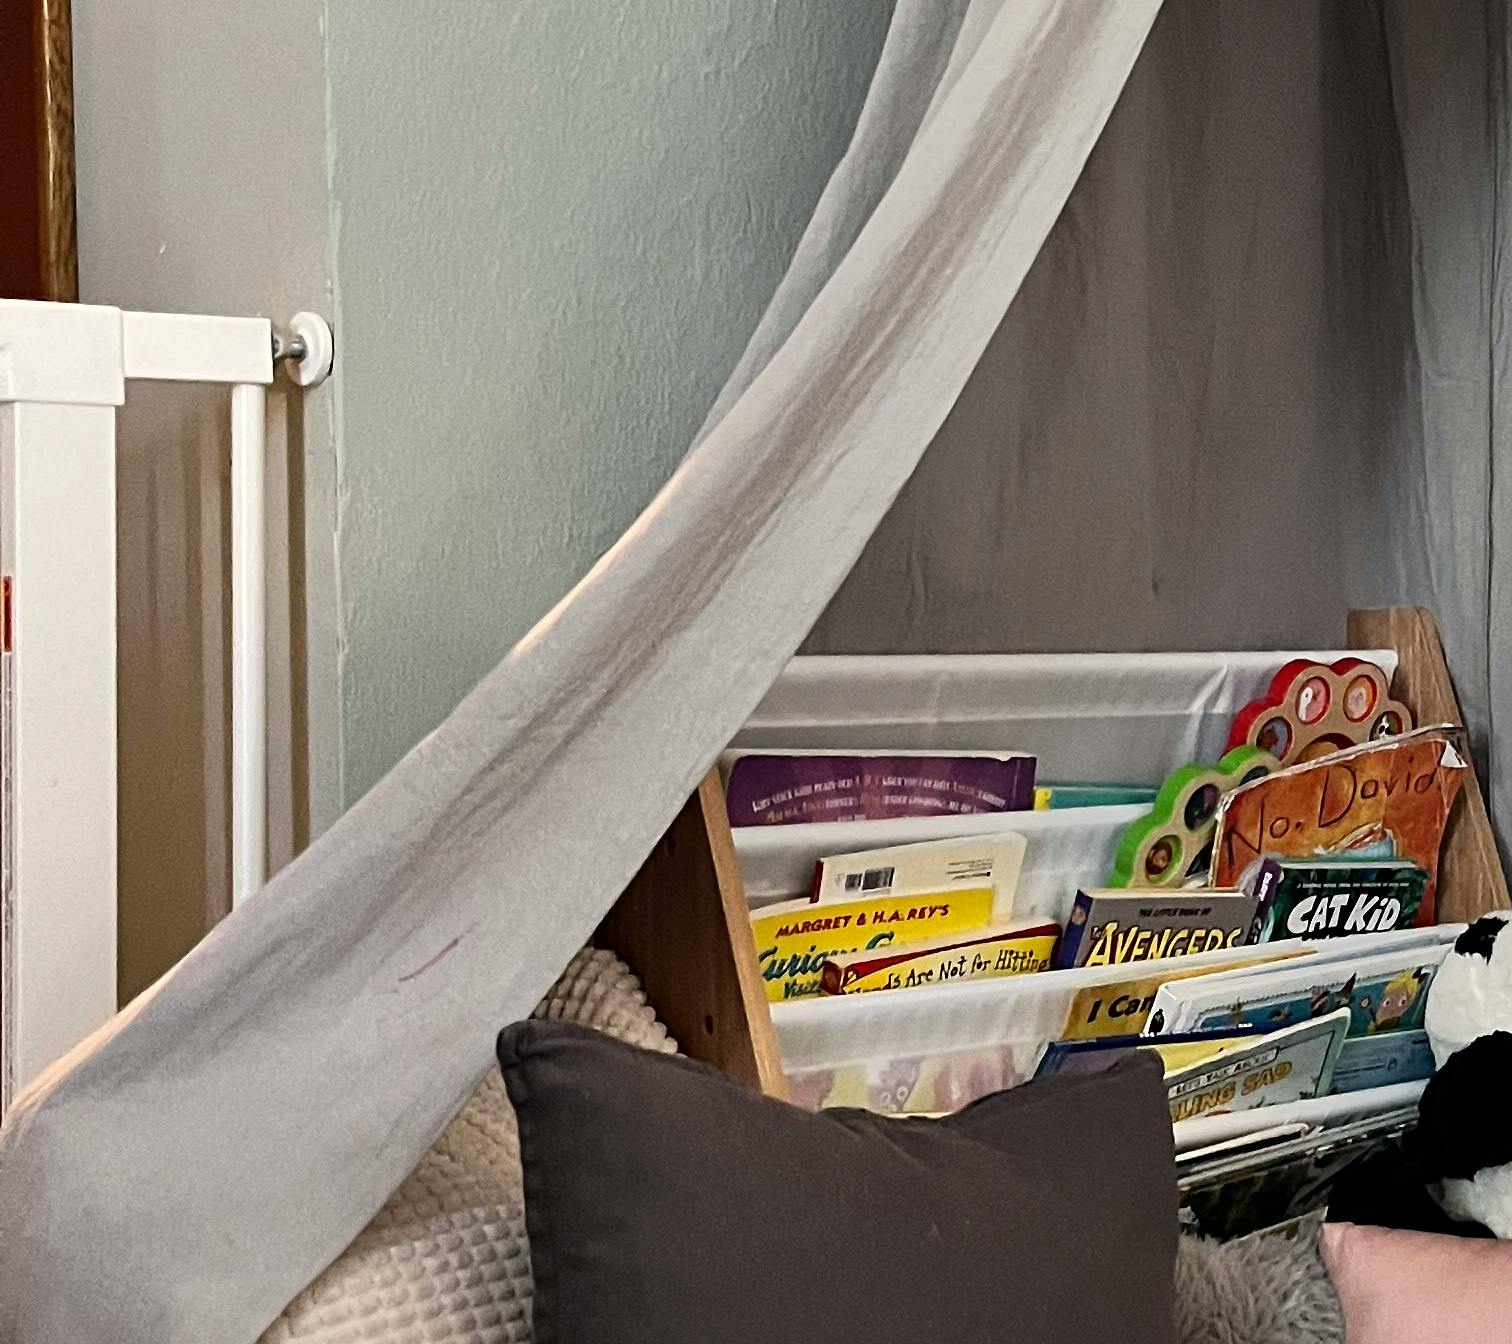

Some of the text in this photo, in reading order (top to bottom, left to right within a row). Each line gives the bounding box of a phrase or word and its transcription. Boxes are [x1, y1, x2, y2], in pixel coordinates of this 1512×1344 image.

[775, 914, 852, 938] MARGRET
[856, 912, 867, 926] &
[1287, 894, 1349, 934] CAT
[1083, 921, 1244, 967] AVENGERS
[905, 968, 933, 988] Are
[940, 955, 967, 981] Not
[971, 953, 991, 973] for
[994, 949, 1049, 973] Hitting
[1087, 999, 1102, 1024] I
[1240, 1061, 1292, 1097] SAD
